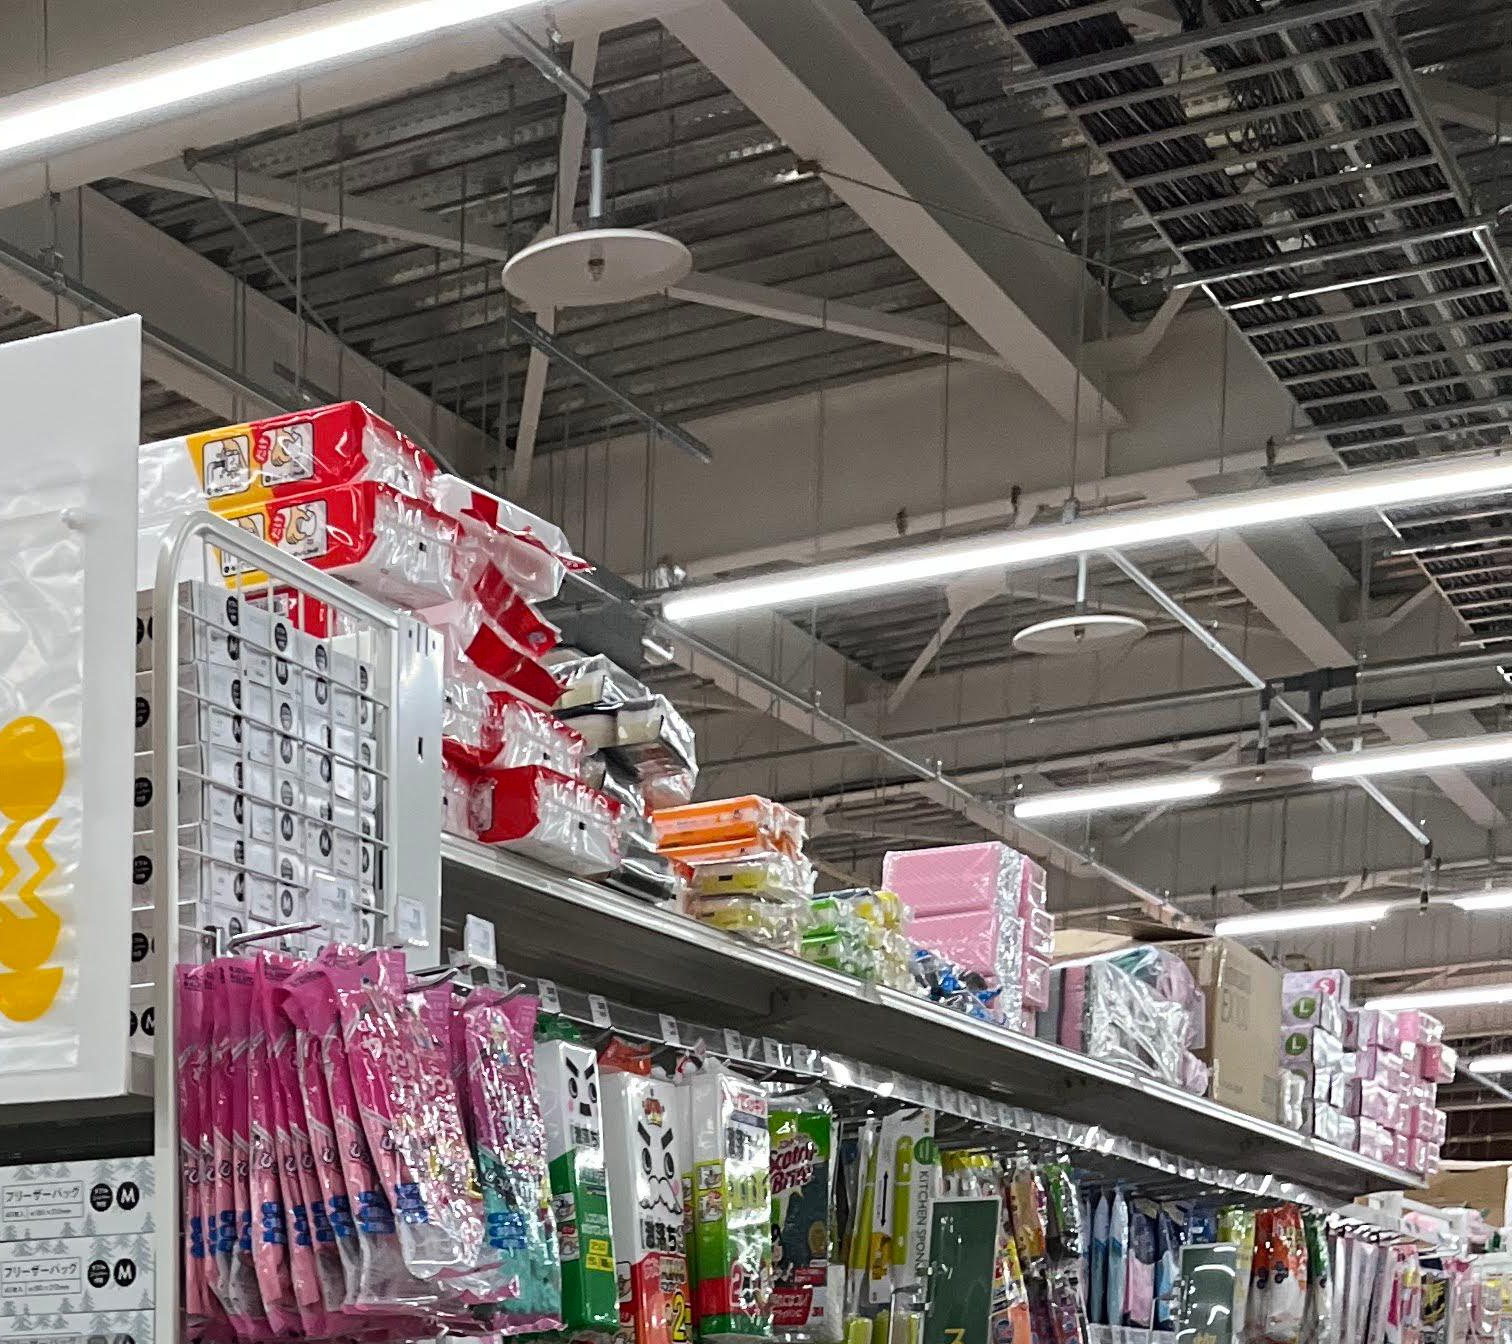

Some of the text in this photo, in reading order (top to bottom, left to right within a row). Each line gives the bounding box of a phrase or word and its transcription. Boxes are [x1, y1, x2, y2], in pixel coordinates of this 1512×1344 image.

[120, 1188, 136, 1204] M
[916, 1170, 929, 1227] KITCHEN
[117, 1264, 133, 1281] M
